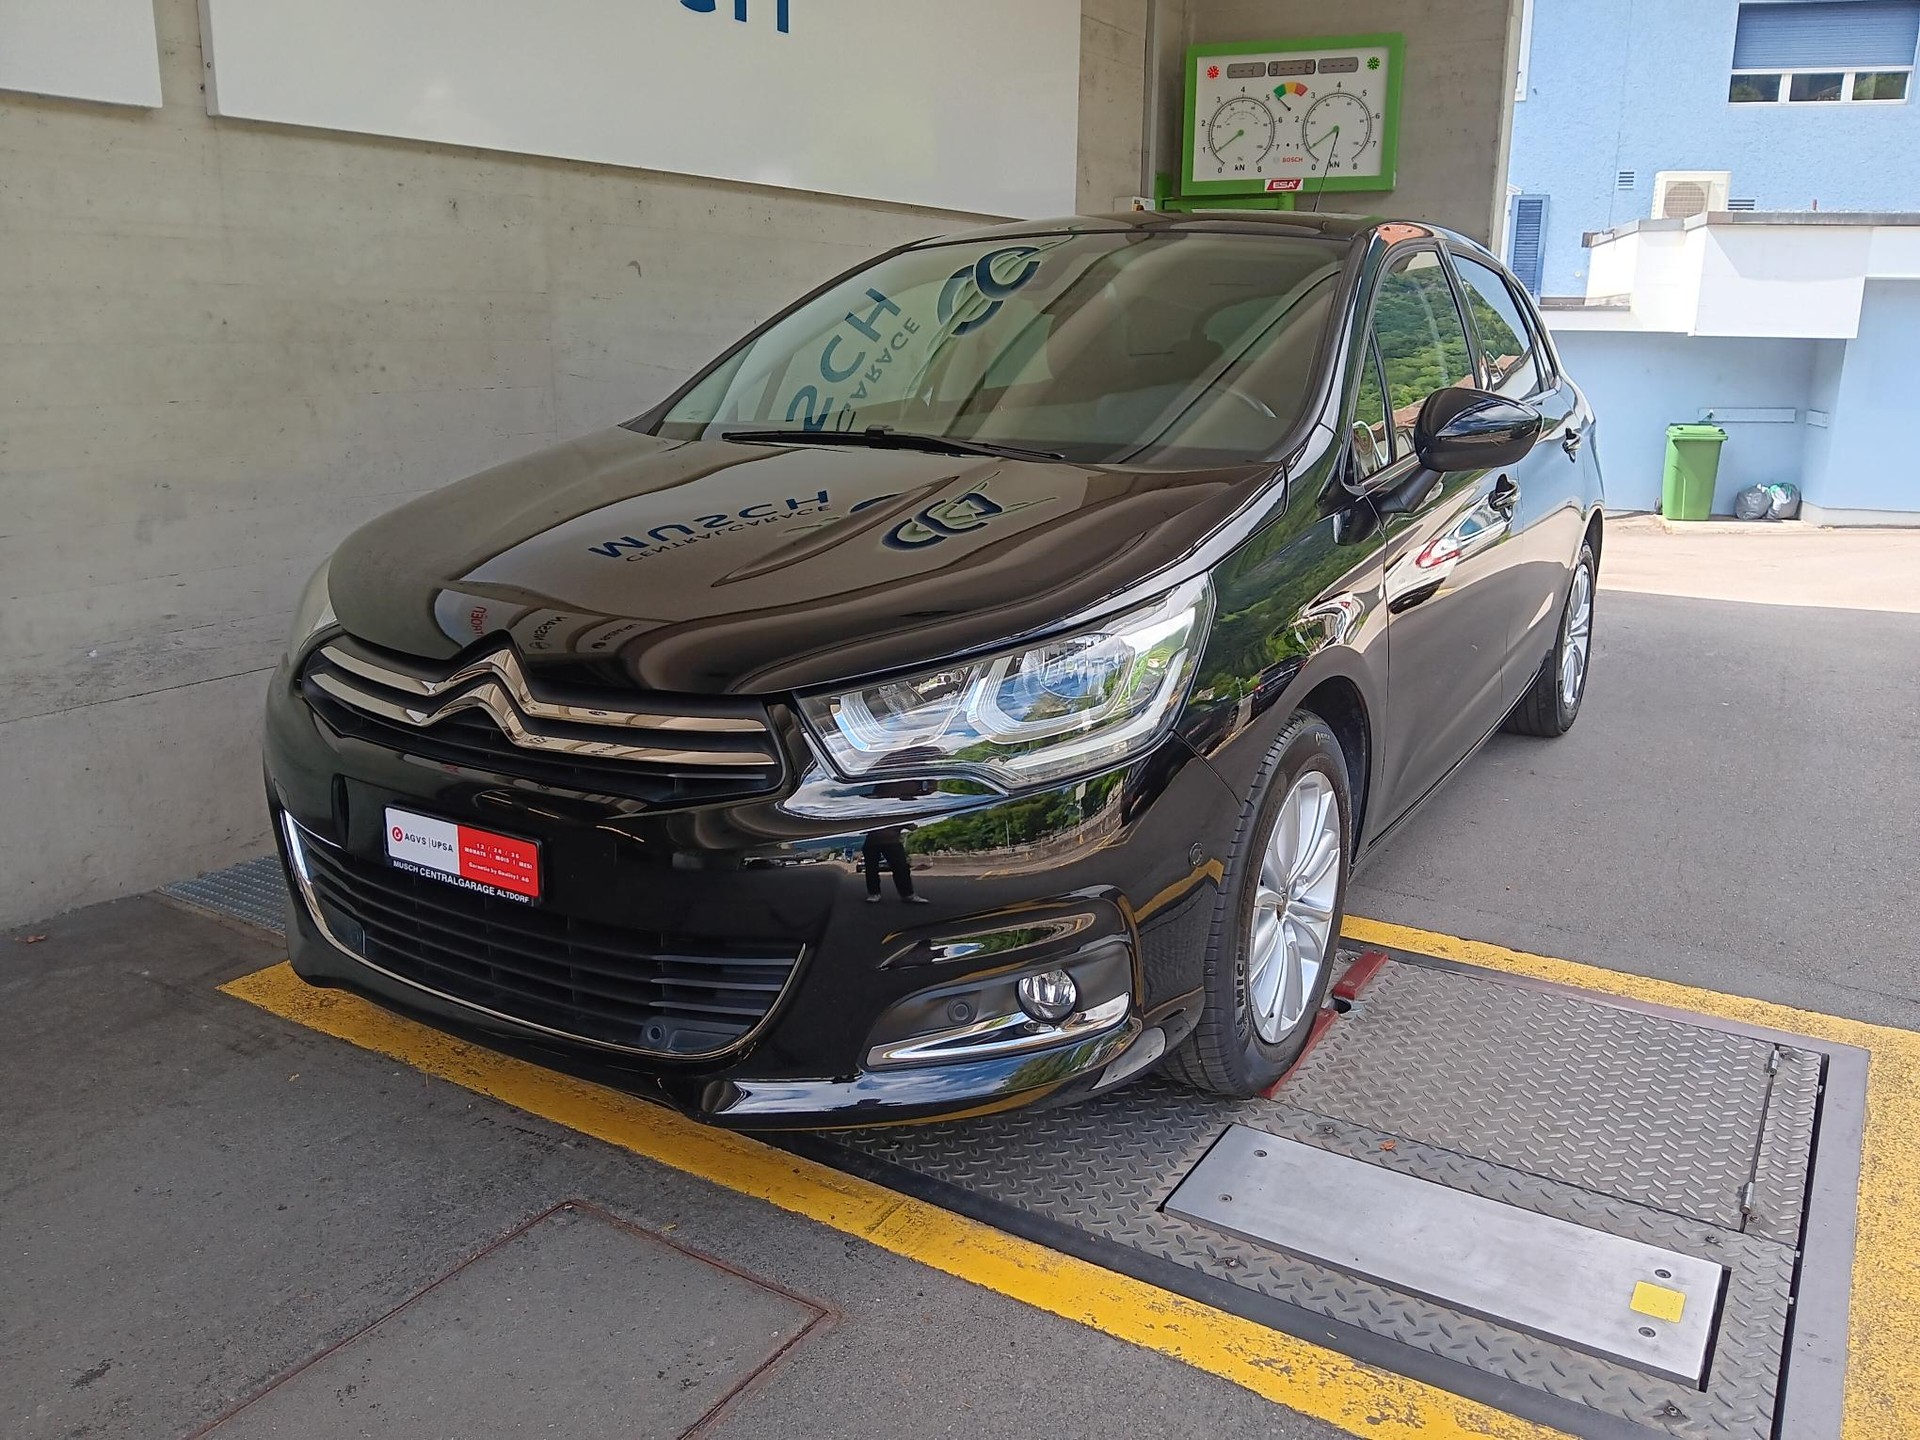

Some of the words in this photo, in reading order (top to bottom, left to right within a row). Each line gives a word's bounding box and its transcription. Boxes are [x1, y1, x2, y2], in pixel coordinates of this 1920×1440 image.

[404, 832, 427, 846] AGVS
[431, 839, 454, 853] UPSA
[393, 860, 419, 873] MUSCH
[419, 867, 495, 896] CENTRALGARAGE
[496, 889, 530, 904] ALTDORF
